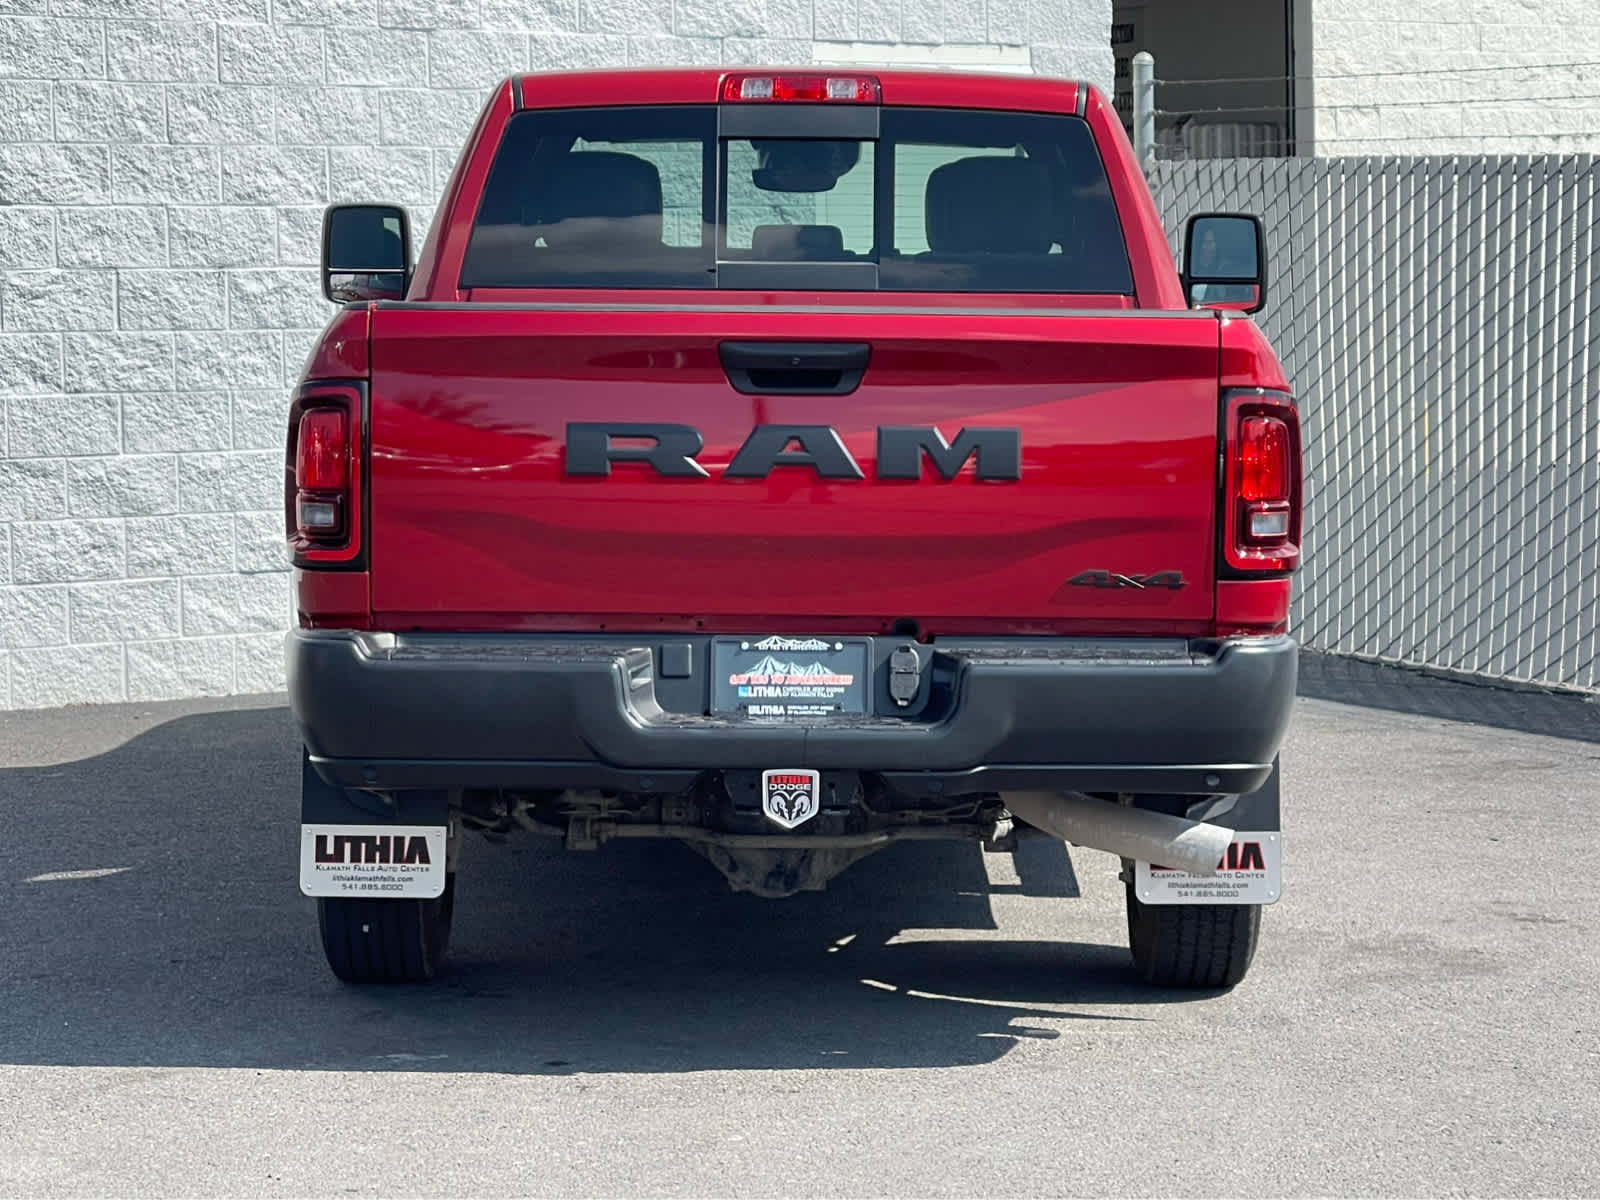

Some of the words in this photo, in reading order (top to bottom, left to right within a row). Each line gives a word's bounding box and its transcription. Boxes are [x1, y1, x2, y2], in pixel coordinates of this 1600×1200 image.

[565, 422, 1021, 480] RAM
[748, 686, 782, 697] LITHIA
[315, 834, 431, 864] LITHIA
